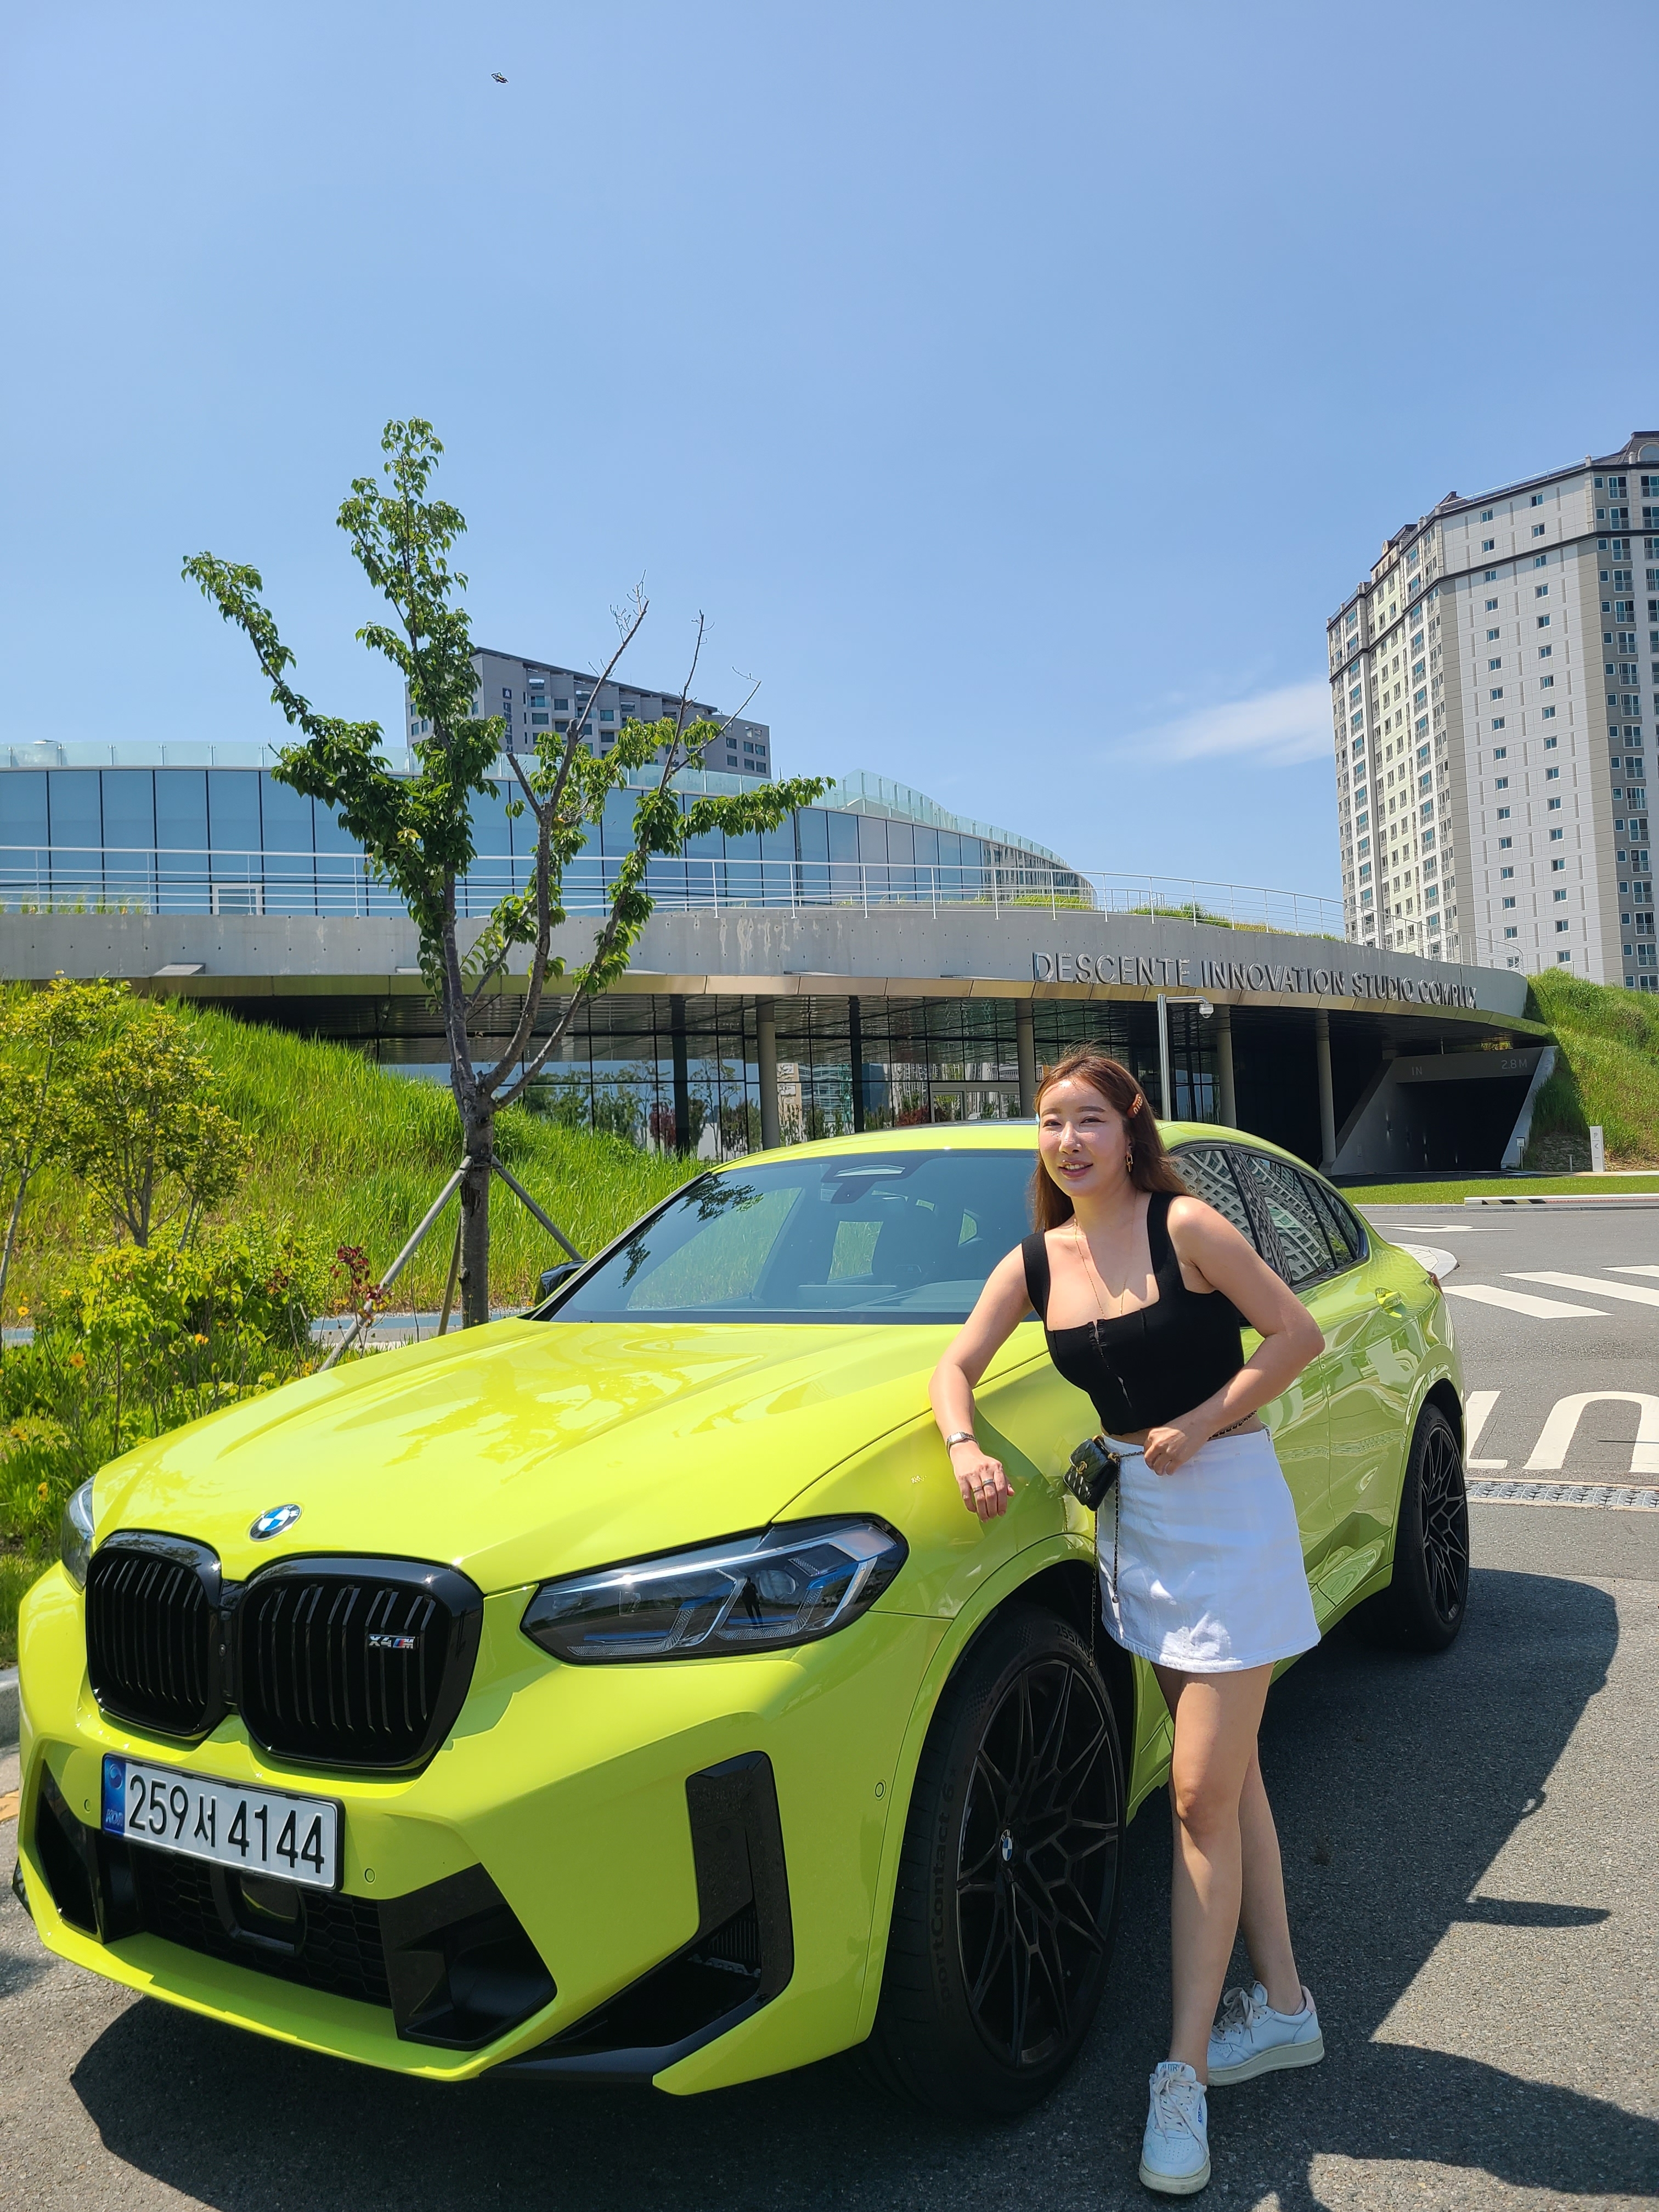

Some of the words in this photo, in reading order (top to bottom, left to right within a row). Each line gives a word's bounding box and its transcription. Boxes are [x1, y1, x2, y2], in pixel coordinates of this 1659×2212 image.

[1032, 952, 1191, 986] DESCENTE
[1201, 960, 1345, 995] INNOVATION
[1352, 972, 1414, 1002] STUDIO
[1412, 1066, 1423, 1076] IN
[105, 1809, 124, 1826] KOR
[128, 1774, 216, 1848] 259서
[228, 1799, 324, 1874] 4144
